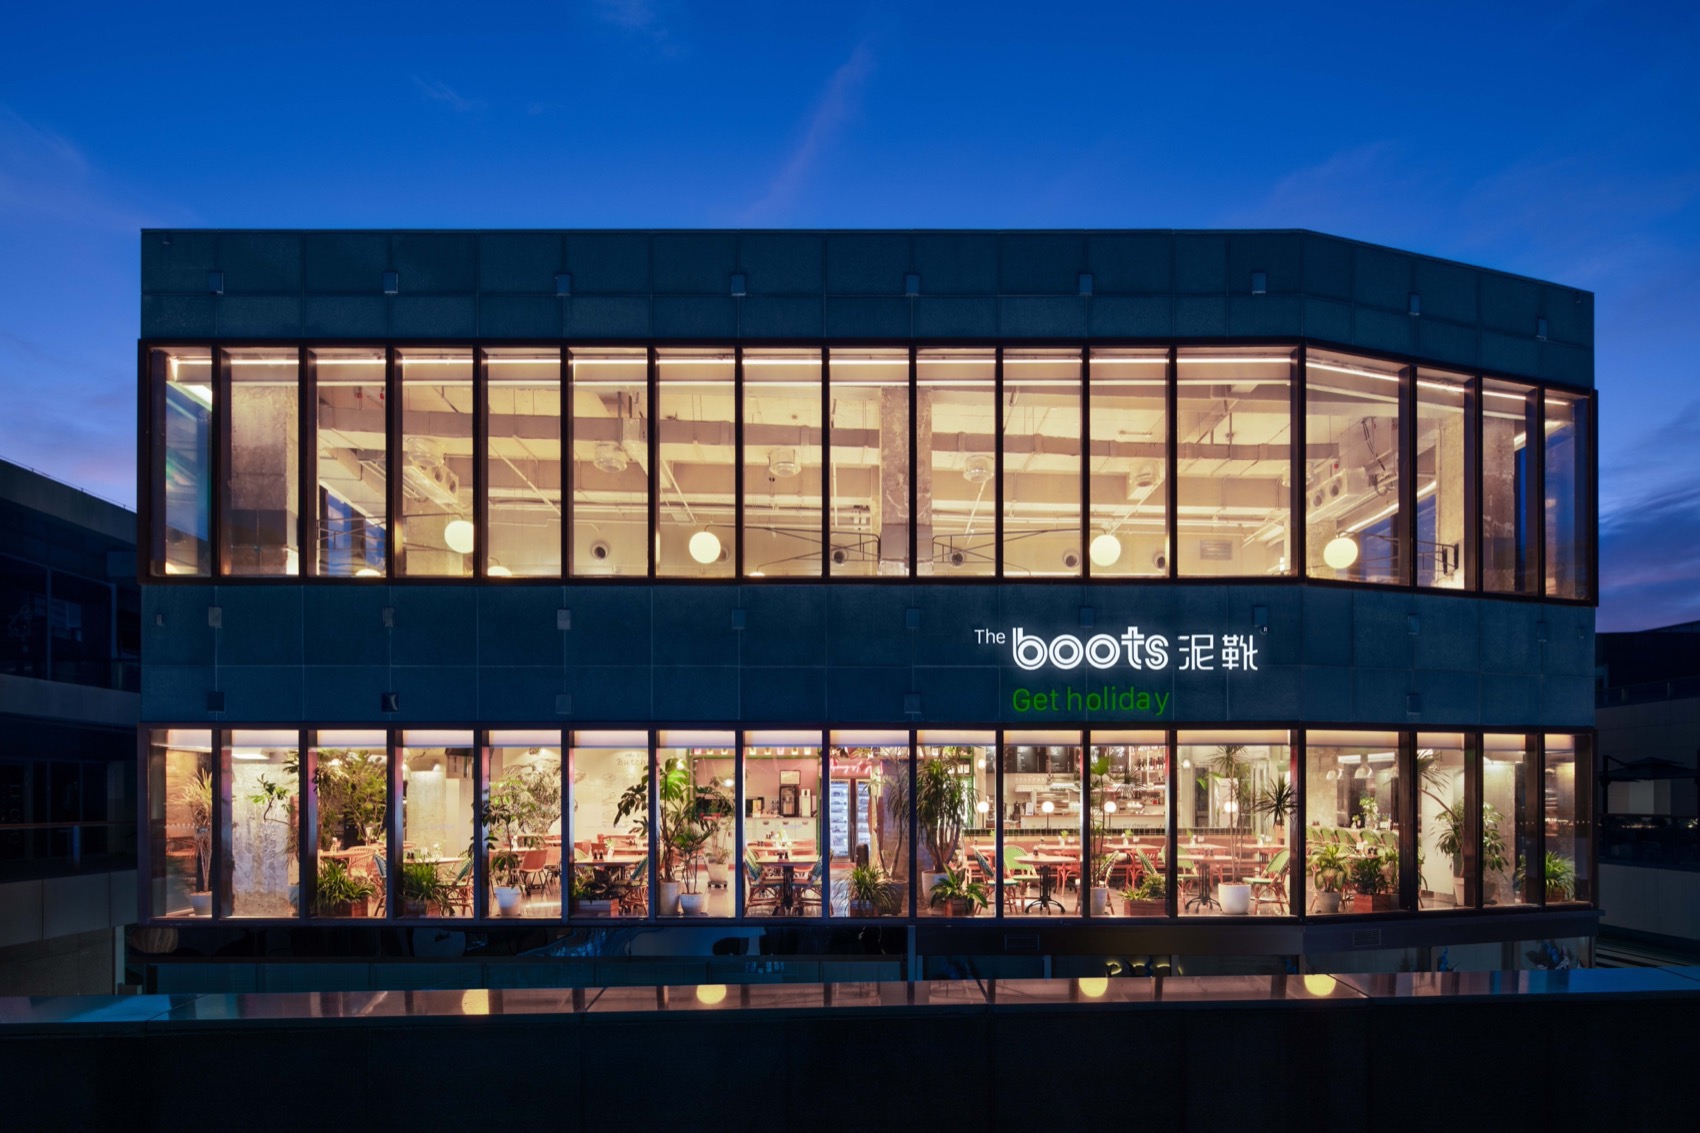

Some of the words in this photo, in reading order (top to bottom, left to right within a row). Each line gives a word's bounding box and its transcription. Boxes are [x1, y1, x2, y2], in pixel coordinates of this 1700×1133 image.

[974, 629, 1005, 644] The
[1012, 626, 1168, 670] boots
[1178, 634, 1258, 671] 泥靴
[1012, 688, 1060, 712] Get
[1066, 686, 1170, 716] holiday
